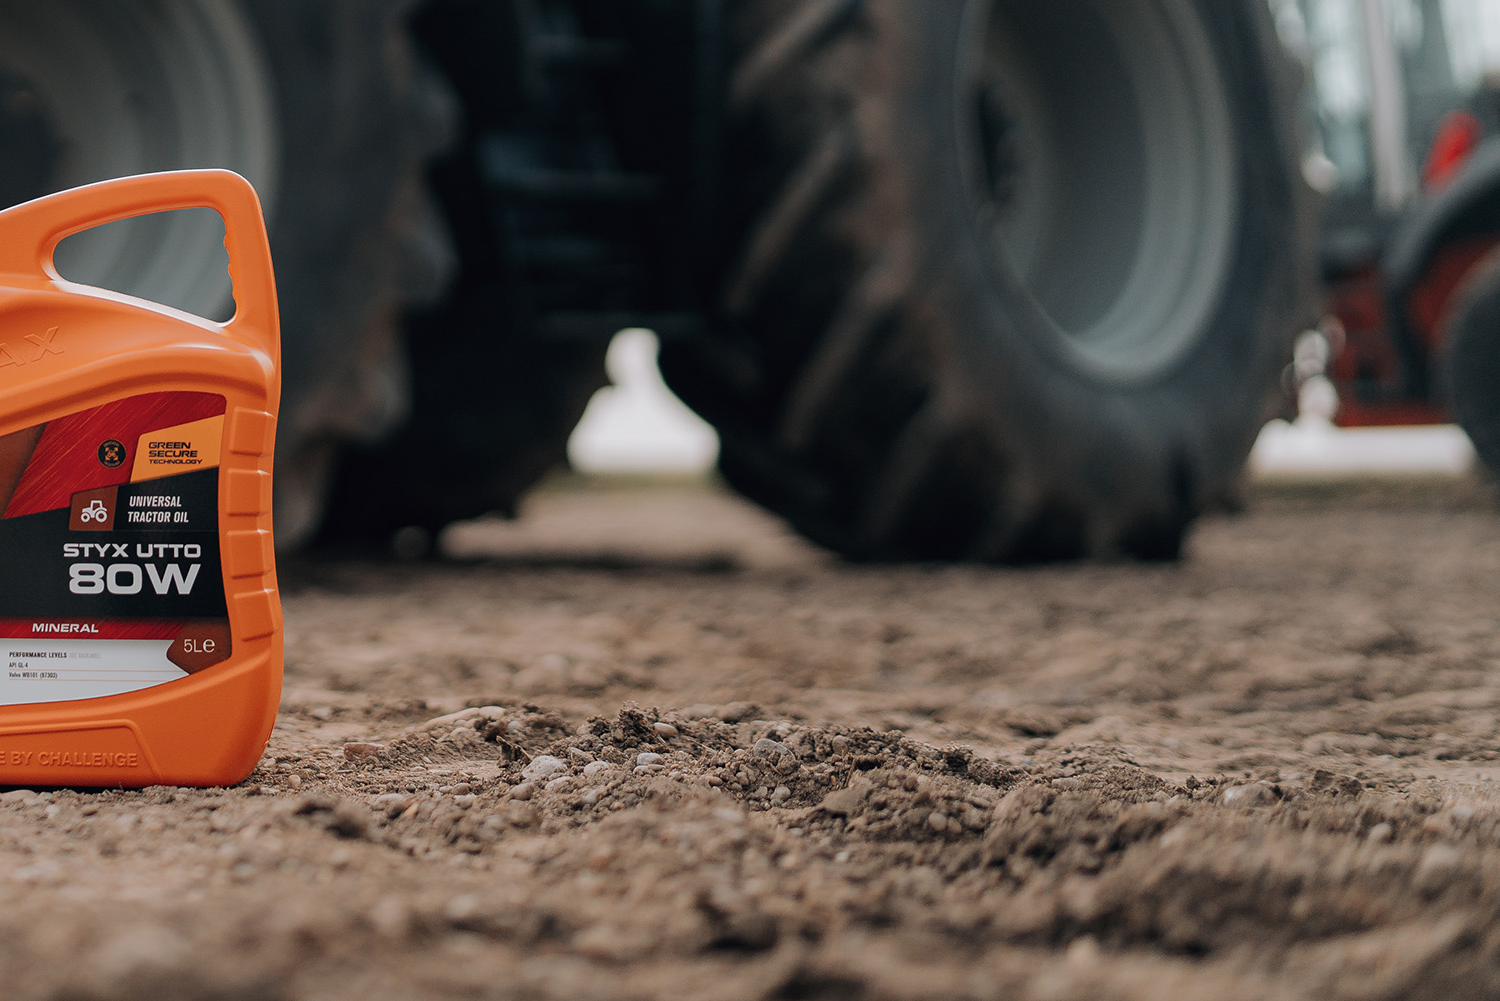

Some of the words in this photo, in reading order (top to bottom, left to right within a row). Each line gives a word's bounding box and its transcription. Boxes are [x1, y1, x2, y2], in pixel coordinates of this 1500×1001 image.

[148, 441, 190, 449] GREEN
[148, 450, 198, 458] SECURE
[129, 496, 182, 508] UNIVERSAL
[127, 511, 171, 523] TRACTOR
[173, 511, 189, 523] OIL
[63, 543, 129, 558] STYX
[136, 543, 202, 558] UTTO
[68, 563, 202, 595] 80W
[32, 623, 99, 633] MINERAL
[10, 751, 33, 766] BY
[37, 752, 138, 768] CHALLENGE
